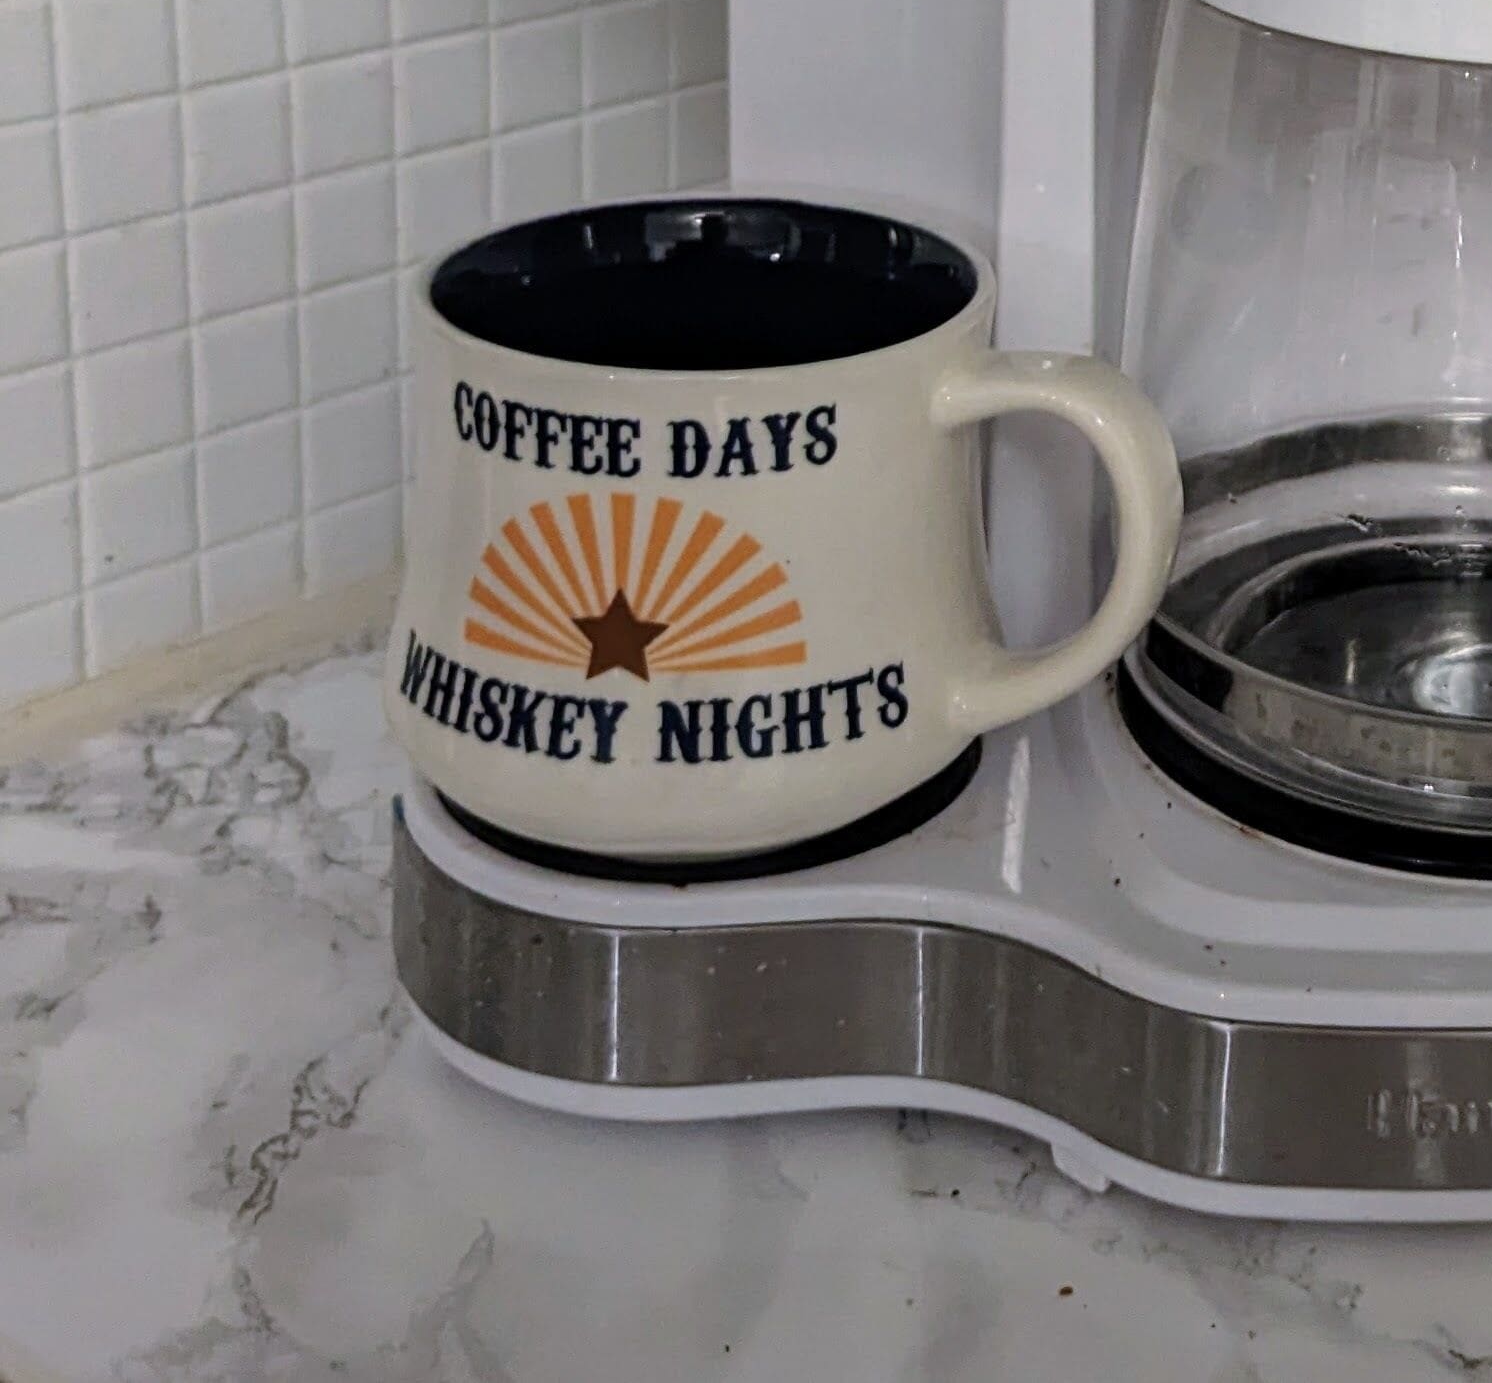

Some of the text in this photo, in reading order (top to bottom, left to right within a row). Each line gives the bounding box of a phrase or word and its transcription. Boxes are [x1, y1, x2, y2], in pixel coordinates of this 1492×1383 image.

[454, 380, 838, 479] COFFEE DAYS
[399, 627, 910, 765] WHISKEY NIGHTS
